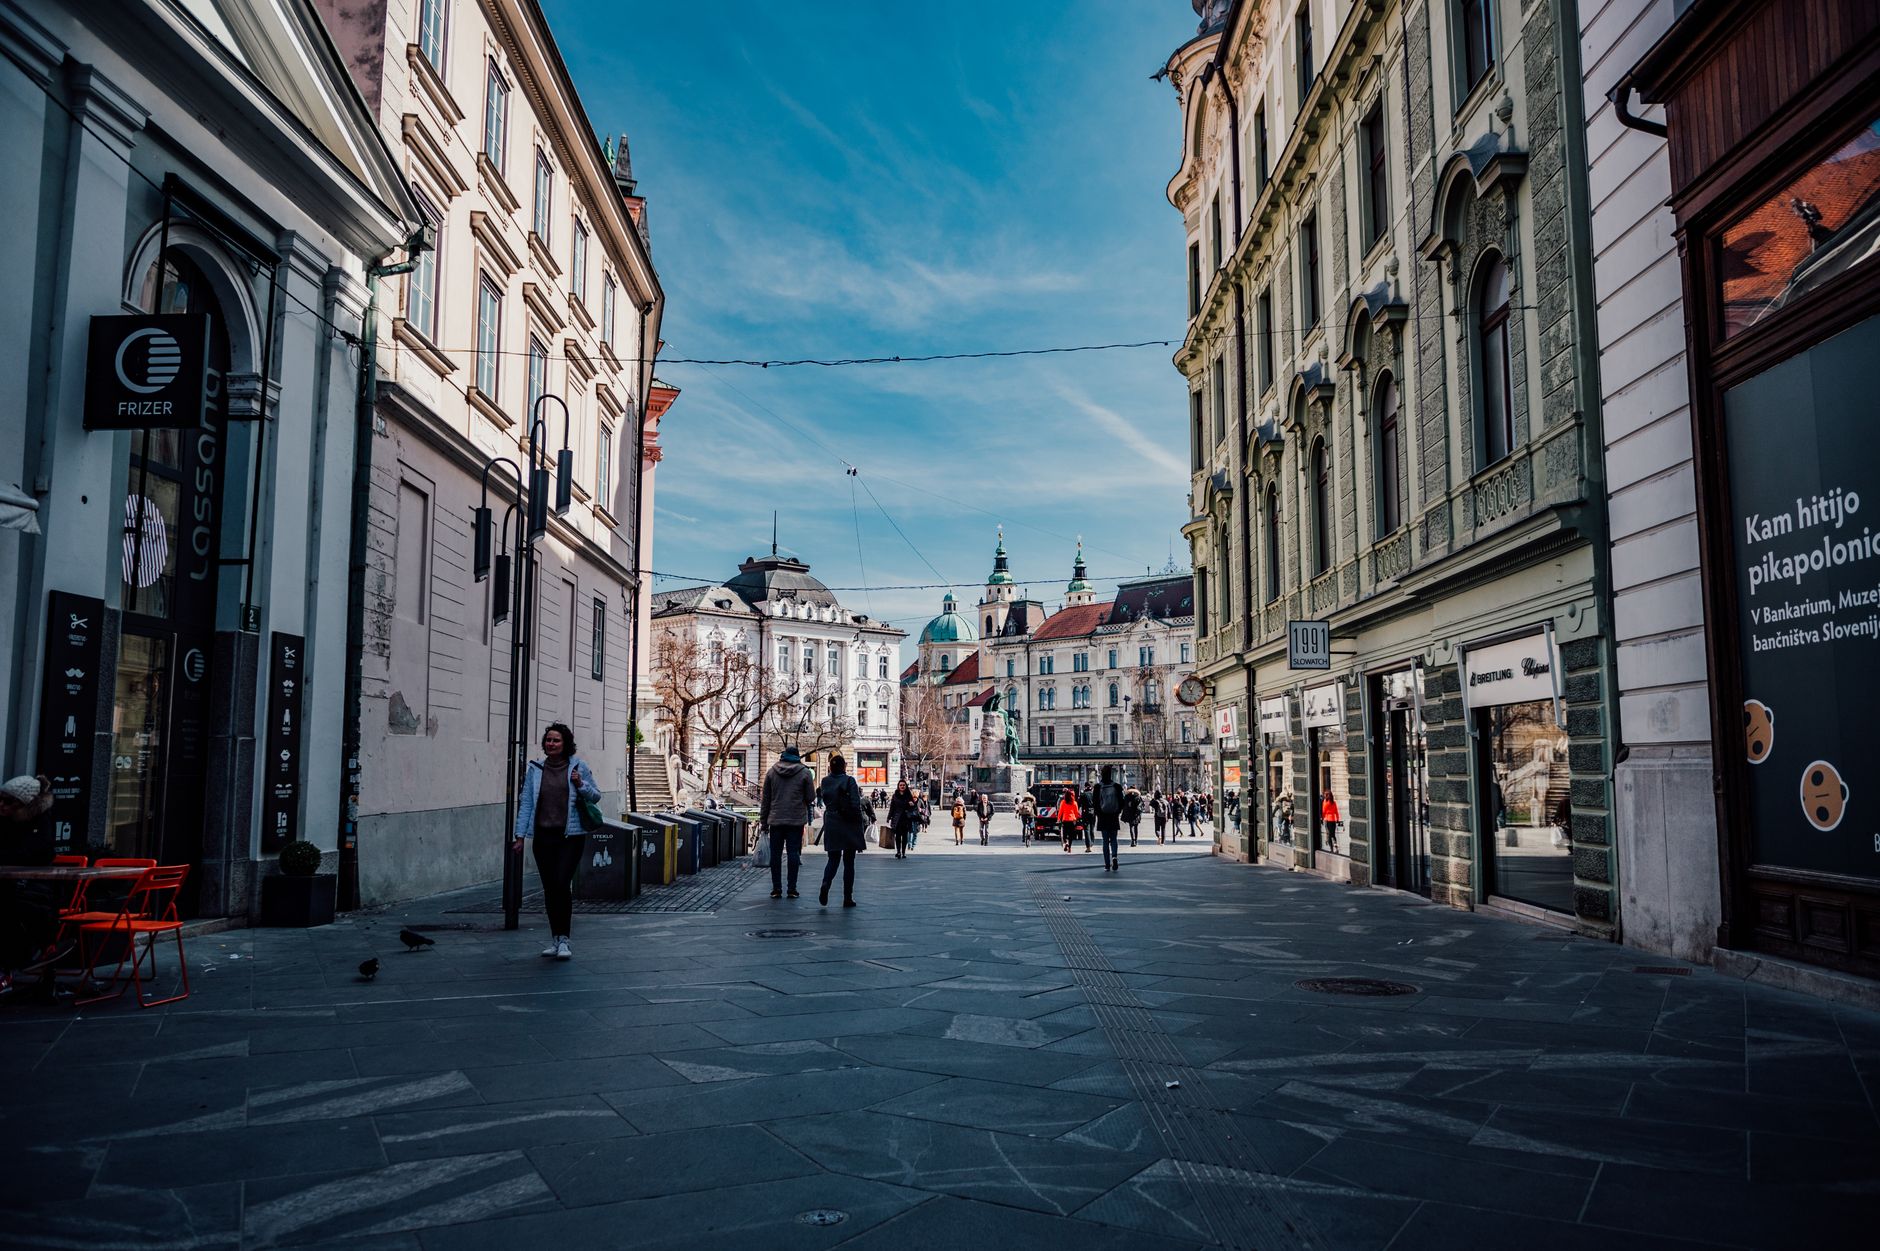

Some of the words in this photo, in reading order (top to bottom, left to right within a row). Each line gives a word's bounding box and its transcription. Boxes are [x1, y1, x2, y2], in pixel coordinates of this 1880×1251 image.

[118, 401, 173, 416] FRIZER
[1745, 512, 1793, 545] Kam
[1796, 487, 1860, 529] hitijo
[1750, 608, 1761, 625] V
[1763, 598, 1836, 624] Bankarium,
[1293, 628, 1326, 654] 1991
[1752, 627, 1820, 652] bančništva
[1822, 614, 1880, 641] Slovenij
[1477, 669, 1512, 684] BREITLING
